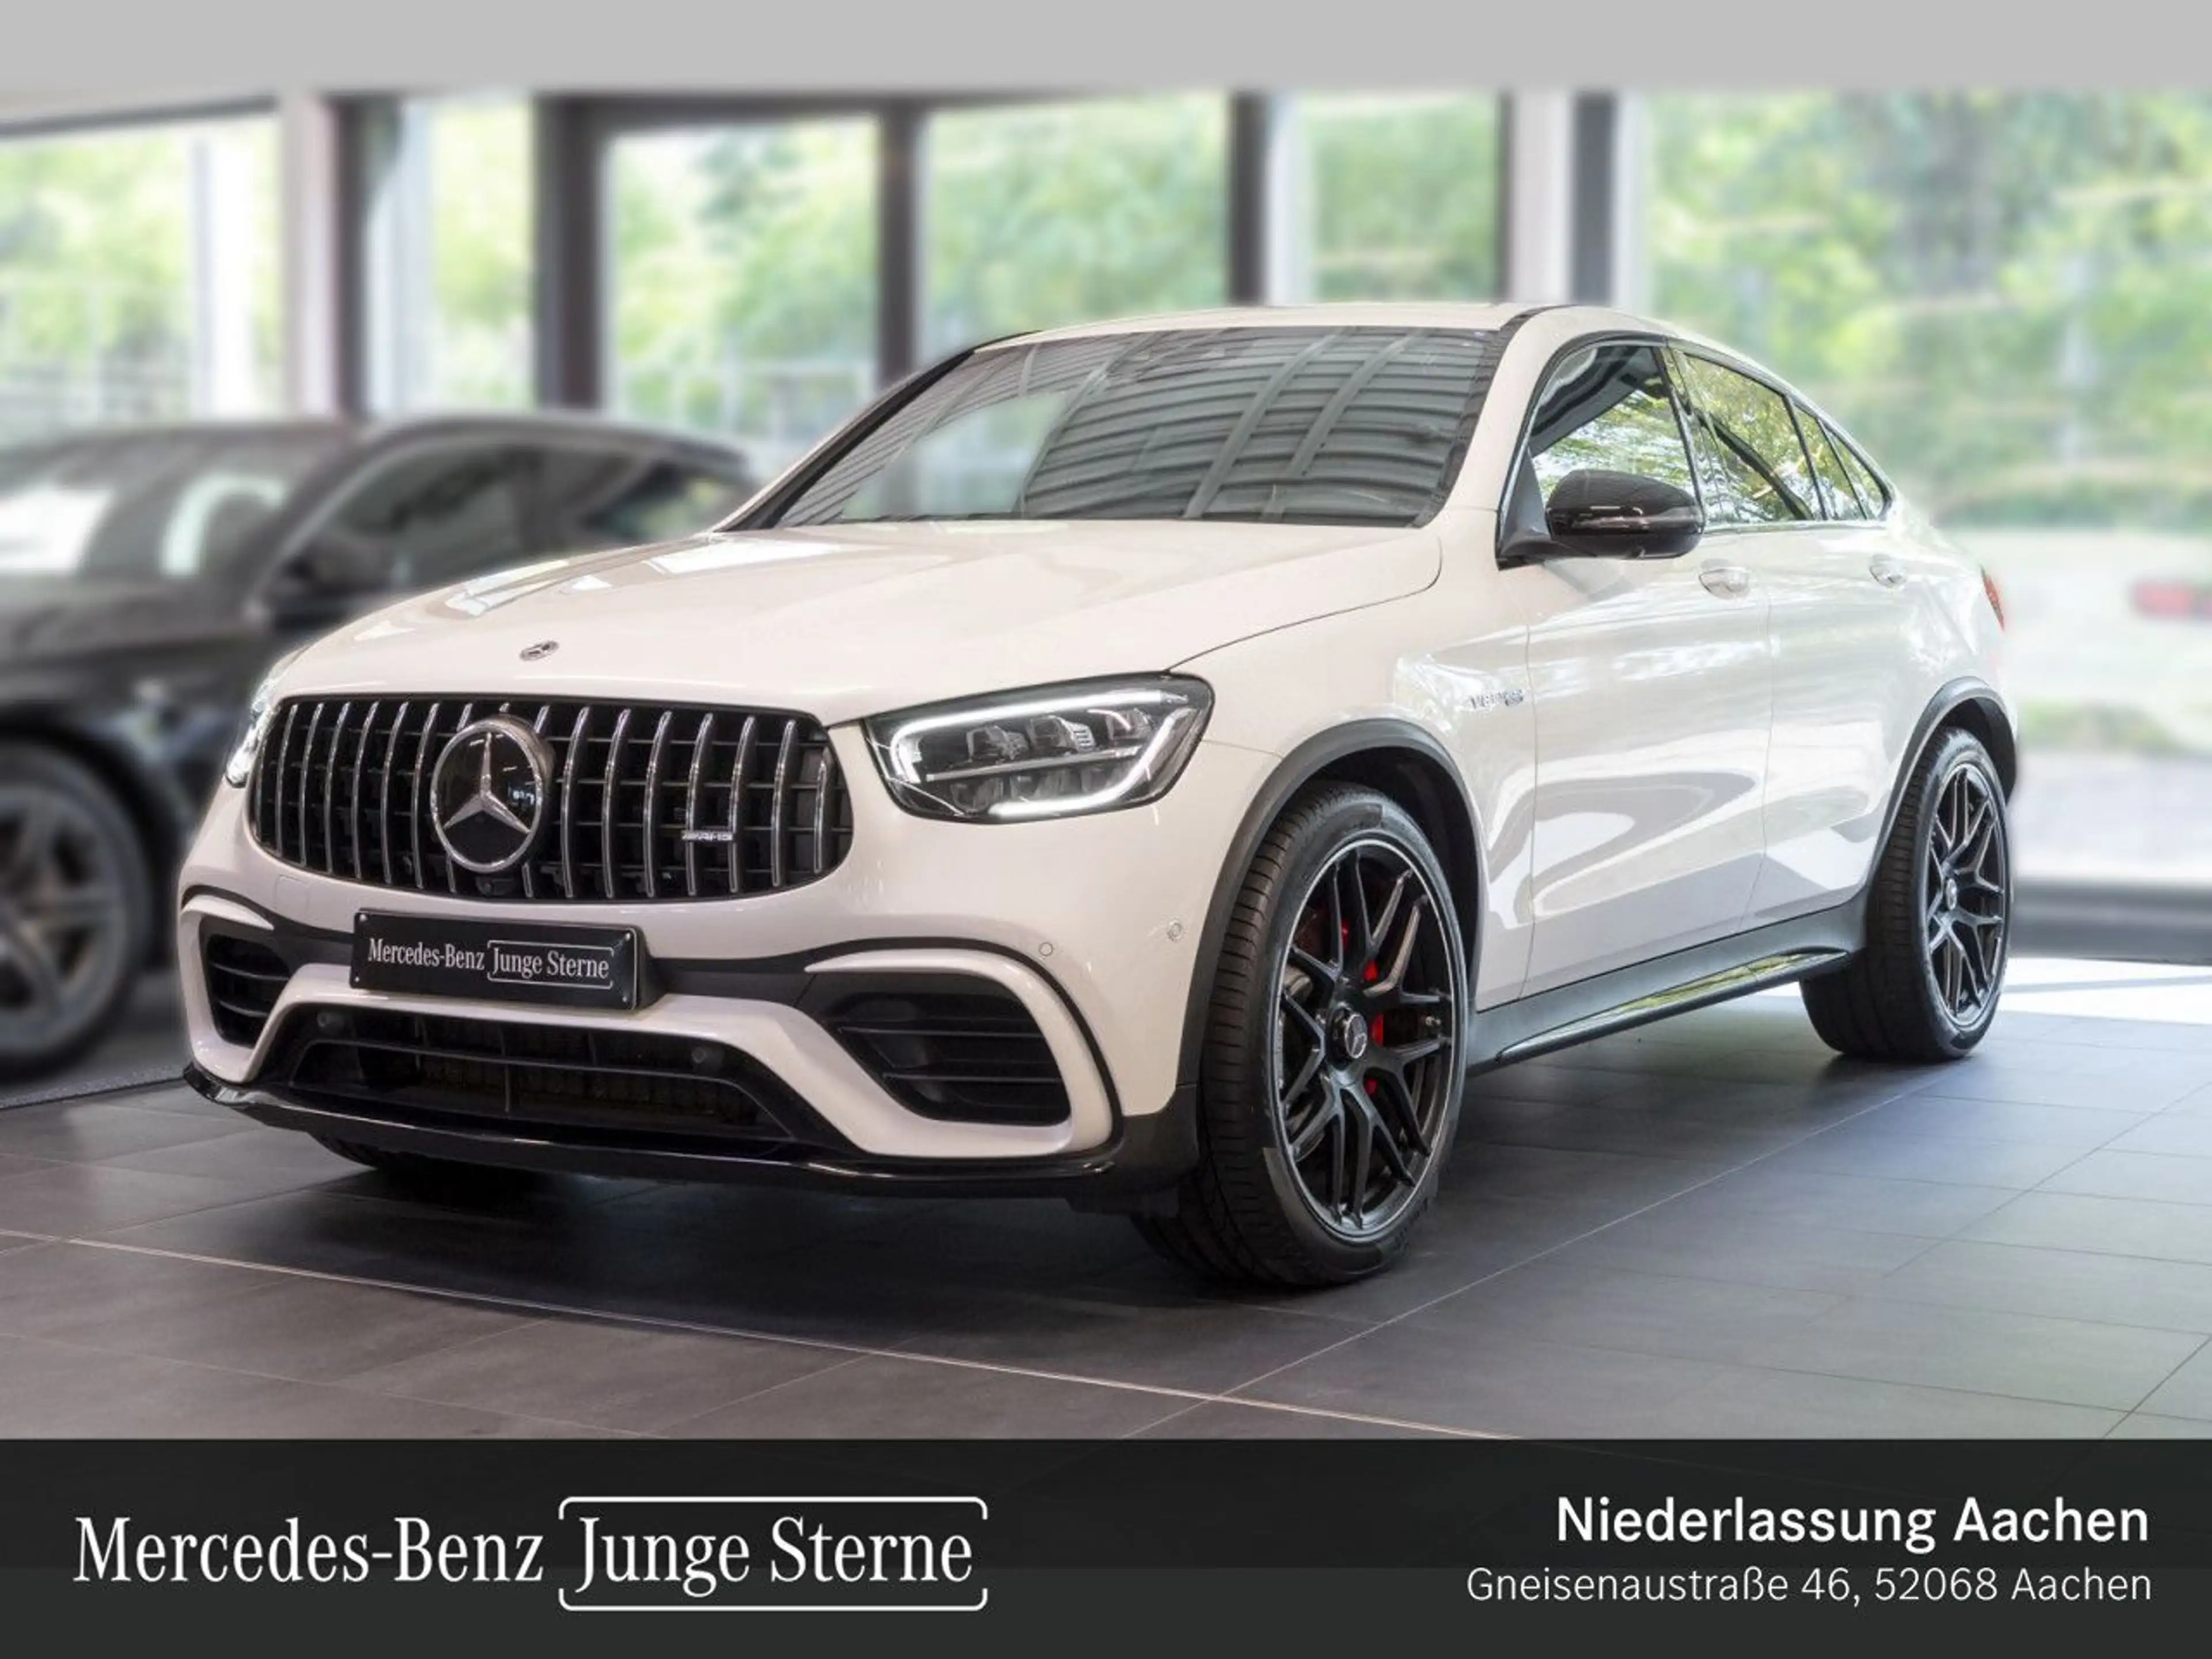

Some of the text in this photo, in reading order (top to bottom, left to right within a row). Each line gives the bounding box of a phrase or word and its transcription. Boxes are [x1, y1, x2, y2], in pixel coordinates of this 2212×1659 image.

[368, 937, 609, 979] Mercedes-Benz Junge Sterne
